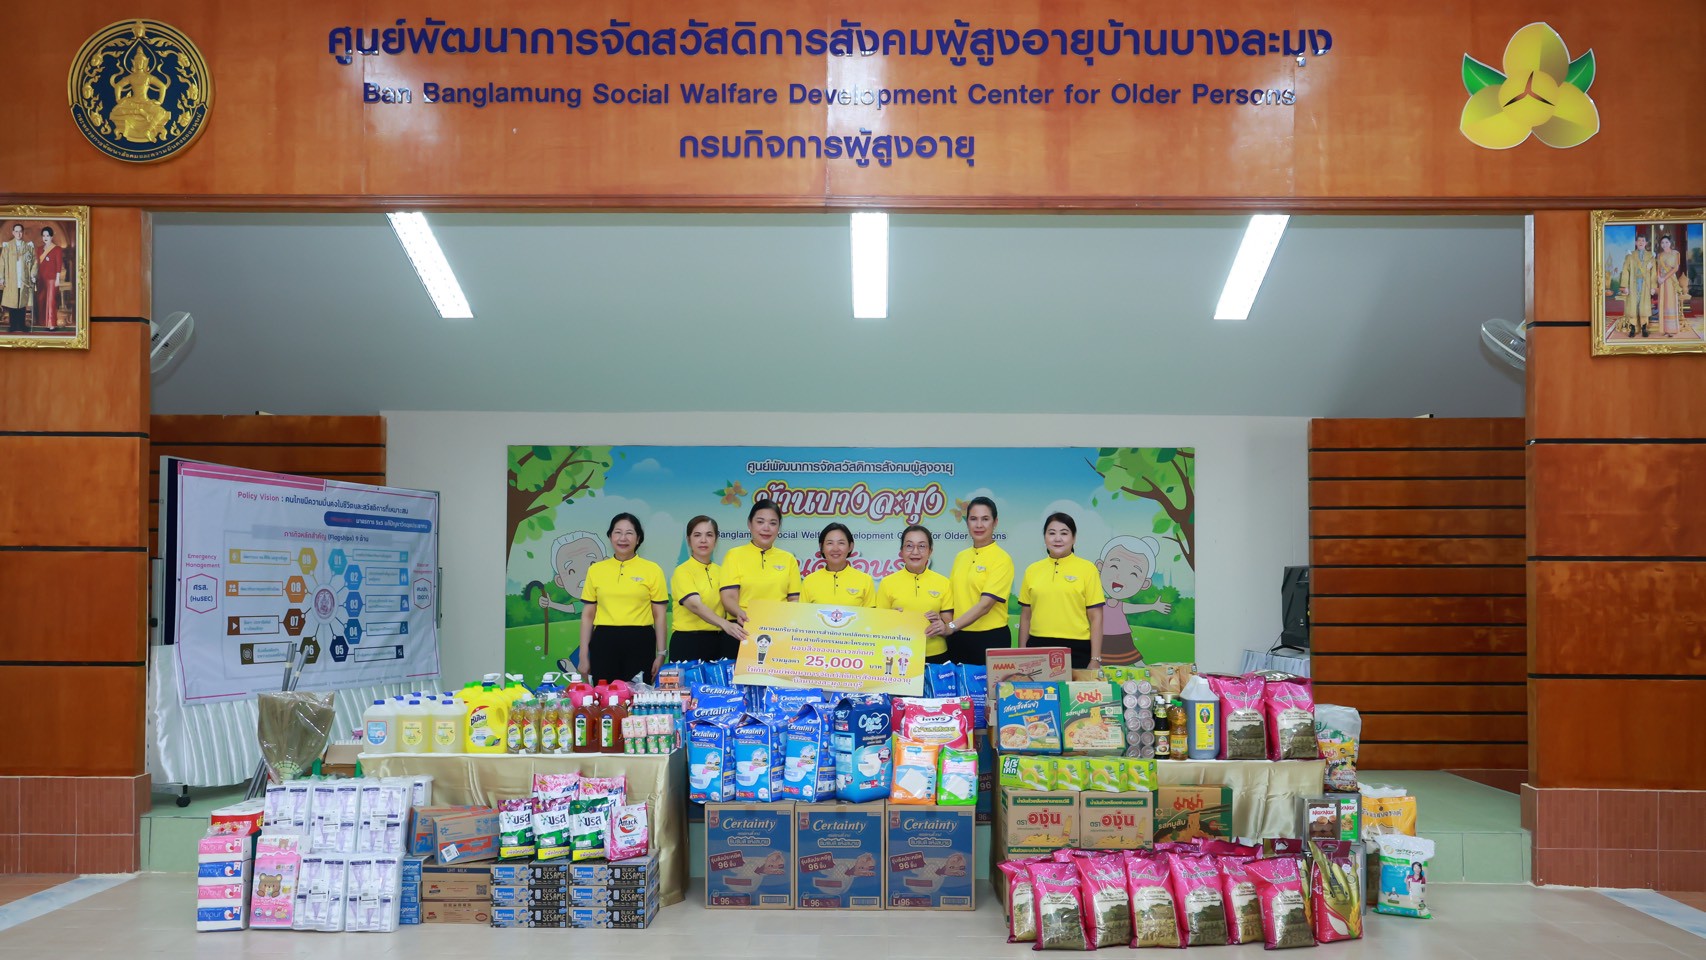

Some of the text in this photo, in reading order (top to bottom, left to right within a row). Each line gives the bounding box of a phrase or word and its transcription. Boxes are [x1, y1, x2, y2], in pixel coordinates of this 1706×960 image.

[328, 17, 1333, 66] ศูนย์พัฒนาการจัดสวัสดิการสังคมผู้สูงอายุบ้านบางละมุง
[363, 82, 1296, 109] Ban Banglamung Social Walfare Development Center for Older Persons
[679, 128, 976, 167] กรมกิจการผู้สูงอายุ
[747, 459, 954, 475] ศูนย์พัฒนาการจัดสวัสดิการสังคมผู้สูงอายุ
[237, 491, 258, 501] Policy
[259, 493, 280, 502] Vision
[717, 530, 752, 540] Banglam
[777, 530, 798, 539] ocial
[801, 530, 820, 539] Welf
[944, 531, 968, 540] Older
[291, 583, 301, 593] 08
[289, 617, 299, 627] 07
[805, 655, 863, 670] 25,000
[992, 663, 1016, 671] MAMA
[722, 817, 776, 831] Certainty
[903, 818, 957, 832] Certainty
[1028, 808, 1061, 828] องุ่น
[1101, 811, 1135, 830] องุ่น
[812, 819, 867, 833] Certainty
[718, 861, 729, 869] 96
[808, 863, 819, 871] 96
[898, 862, 910, 870] 96
[810, 899, 820, 907] 96
